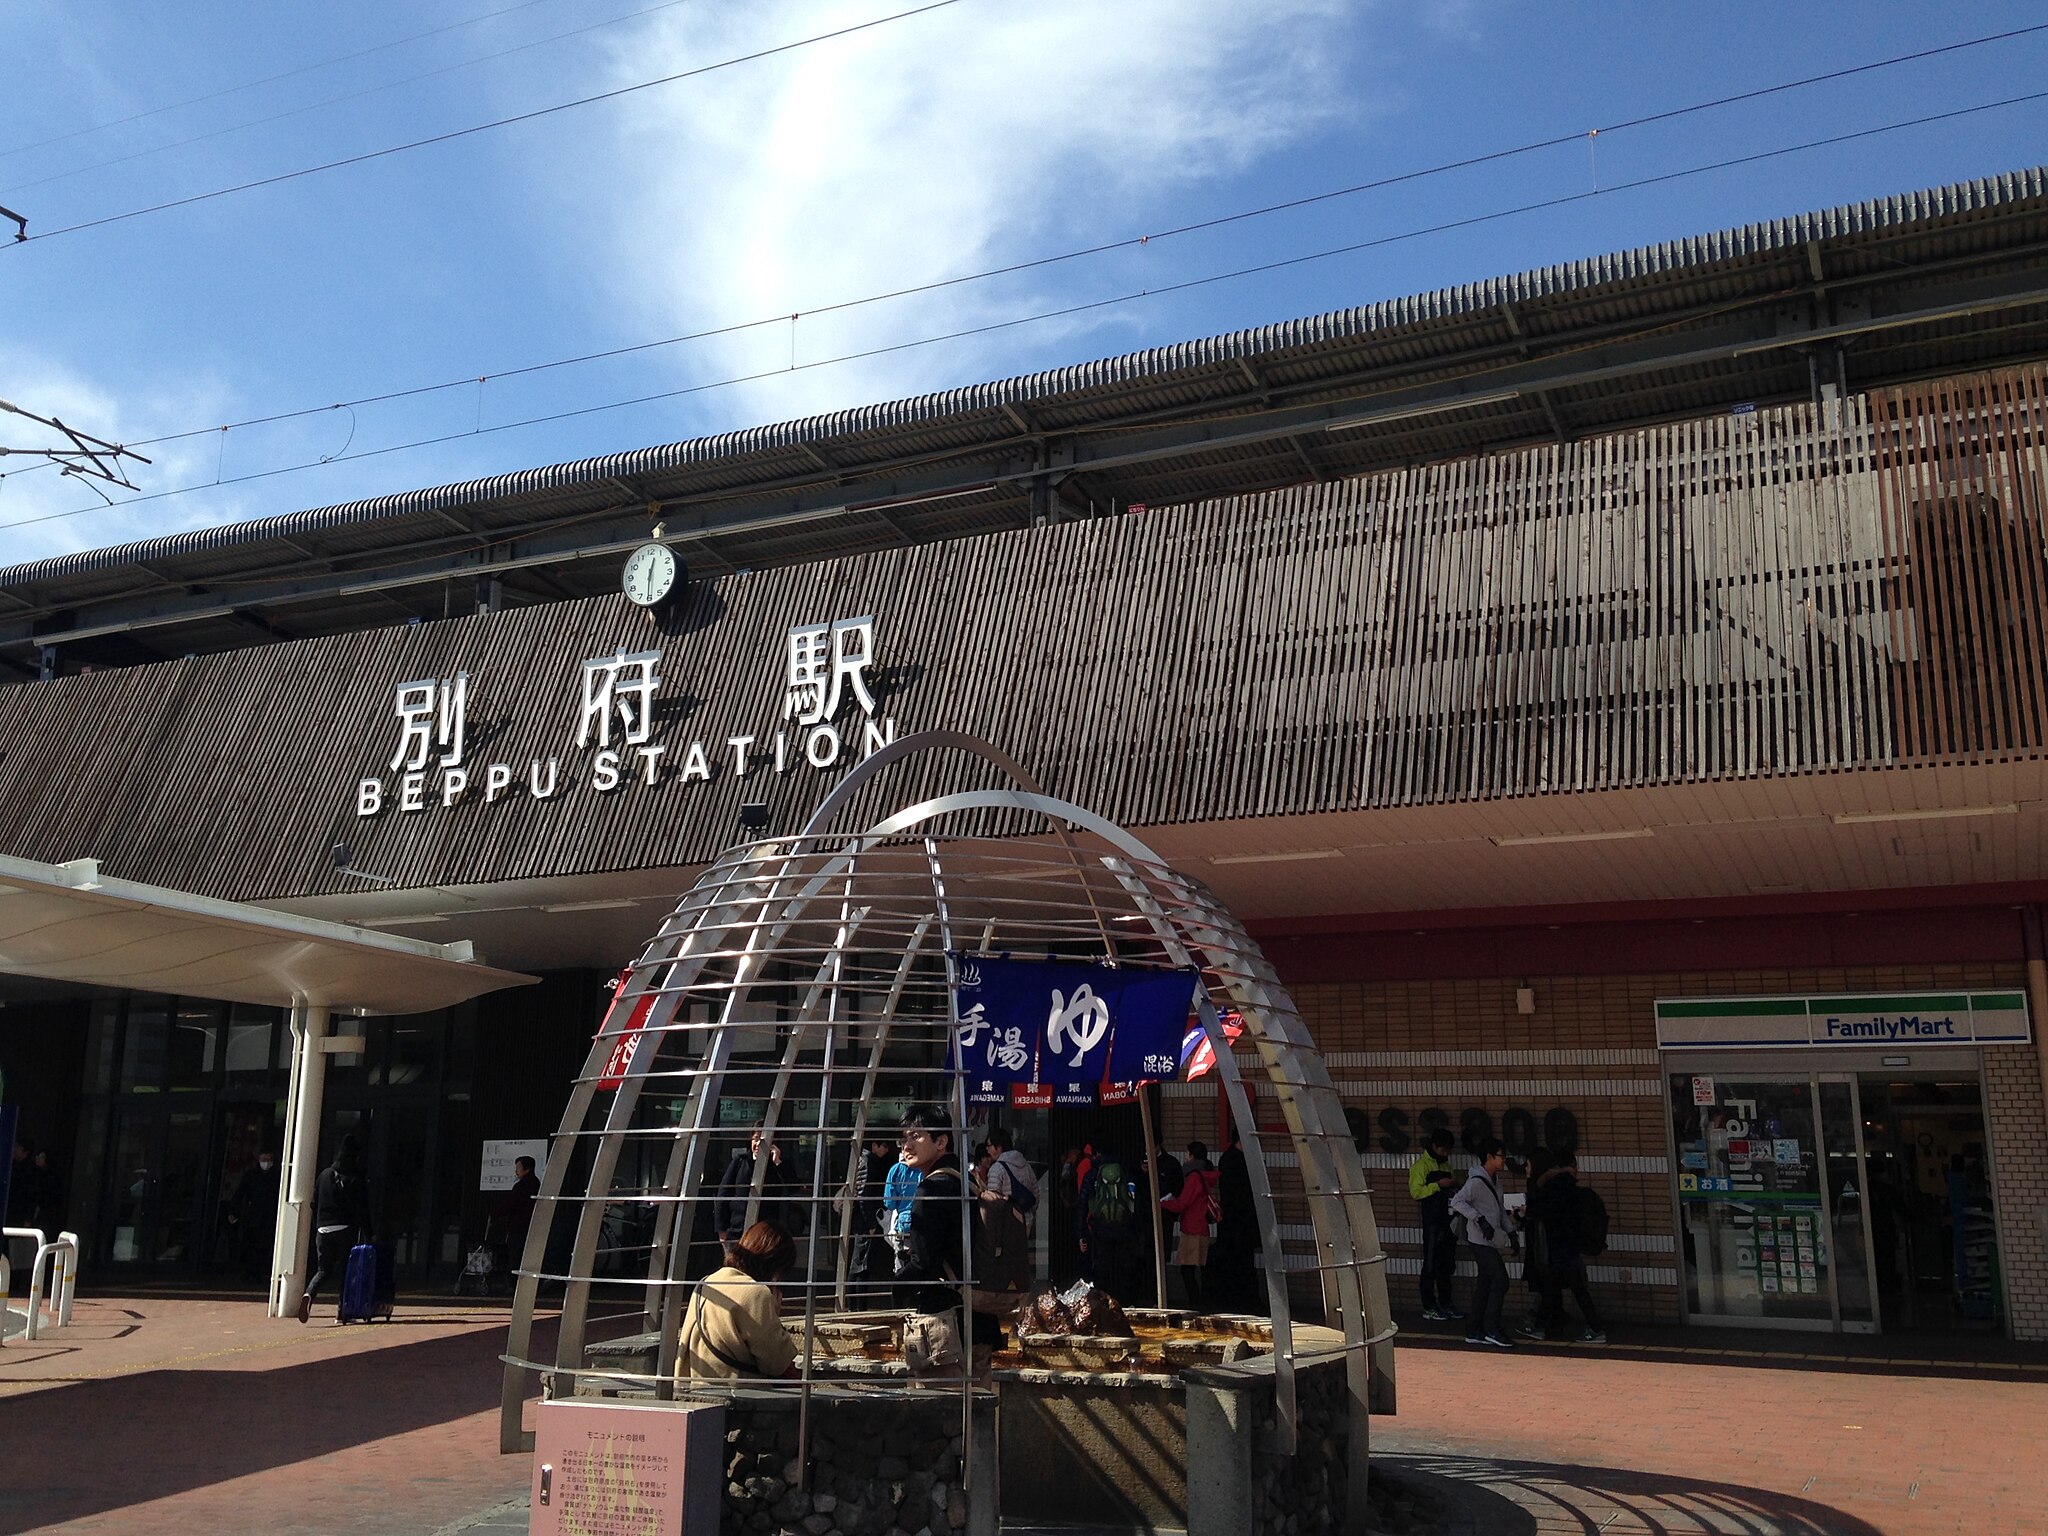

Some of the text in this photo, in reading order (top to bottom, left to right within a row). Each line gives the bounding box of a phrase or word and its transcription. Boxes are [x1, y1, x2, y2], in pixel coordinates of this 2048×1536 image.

[391, 615, 876, 771] 別府駅
[357, 718, 895, 816] BEPPU STATION
[958, 1002, 1029, 1071] 手湯
[1047, 983, 1109, 1068] ゆ
[1826, 1016, 1954, 1040] FamilyMart
[1701, 1178, 1728, 1191] お酒
[587, 1431, 646, 1443] モニュメントの説明
